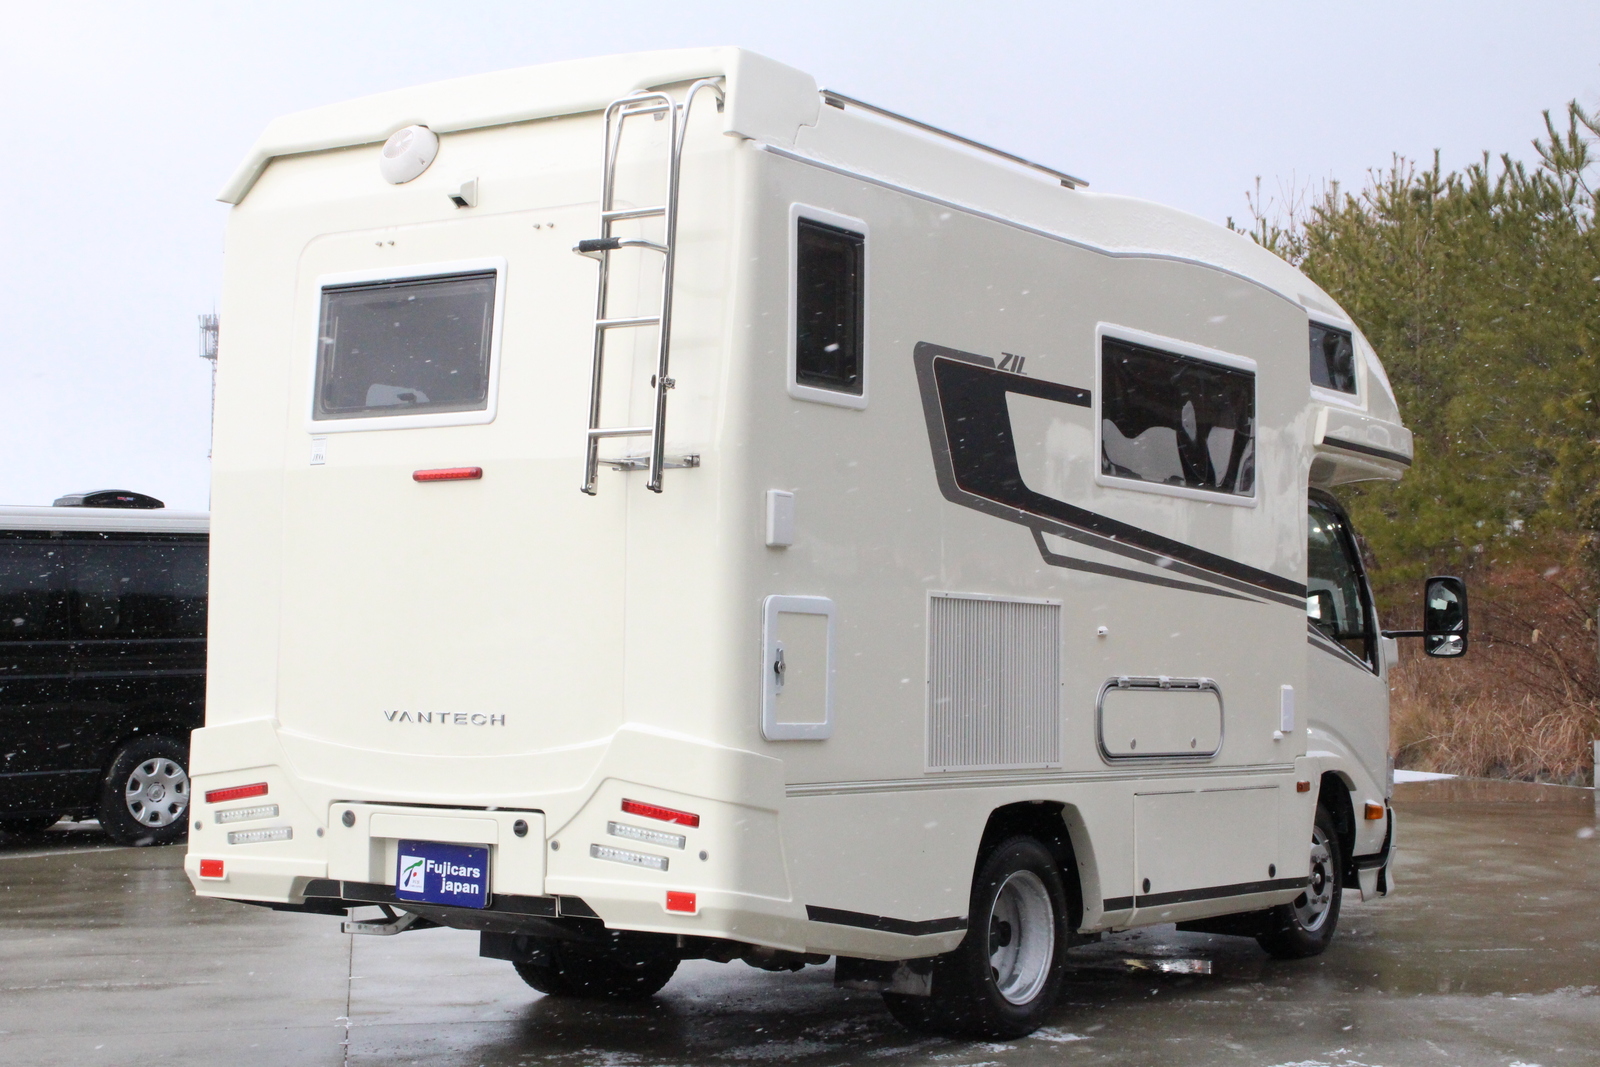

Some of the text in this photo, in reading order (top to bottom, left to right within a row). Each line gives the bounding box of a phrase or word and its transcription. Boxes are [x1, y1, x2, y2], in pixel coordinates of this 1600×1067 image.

[384, 709, 505, 726] VANTECH
[426, 859, 481, 879] Fujicars
[440, 877, 479, 895] japan
